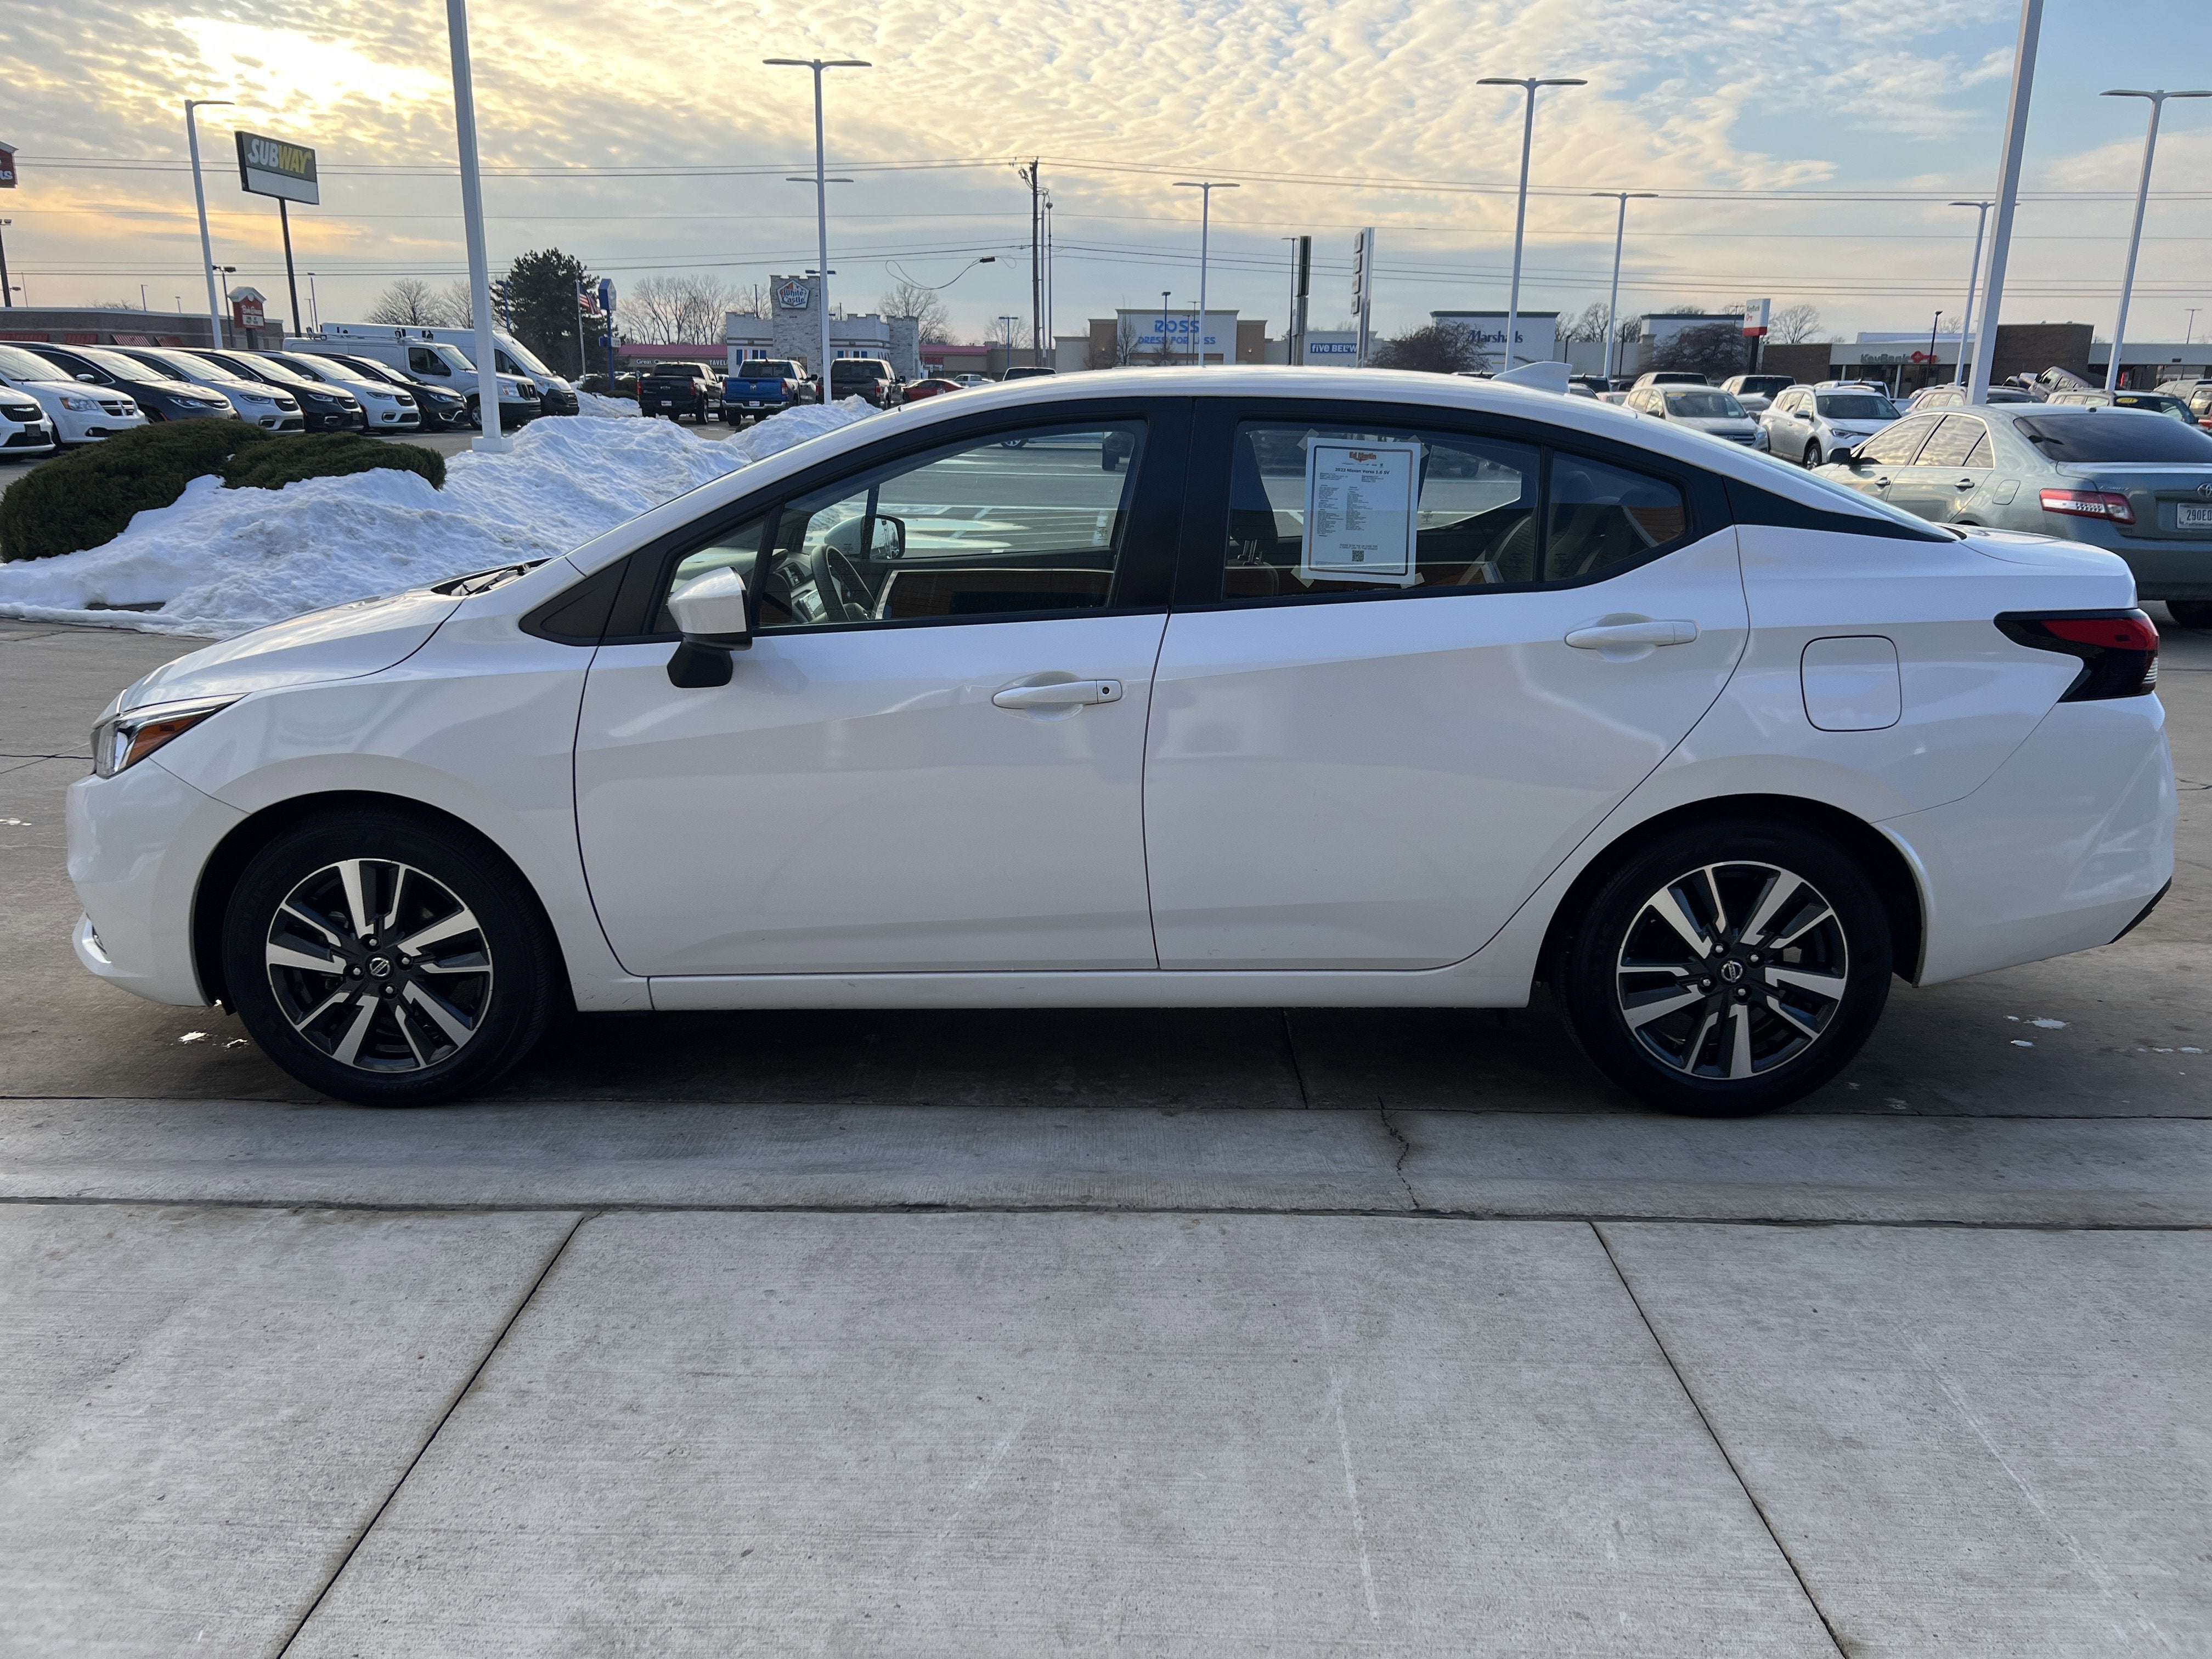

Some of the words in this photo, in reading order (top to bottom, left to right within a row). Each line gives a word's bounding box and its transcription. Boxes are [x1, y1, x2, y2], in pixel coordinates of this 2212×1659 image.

[247, 138, 312, 174] SUBWAY
[783, 289, 804, 297] White
[1154, 320, 1200, 333] ROSS
[1193, 336, 1216, 345] LSS
[1468, 330, 1523, 343] Marshls
